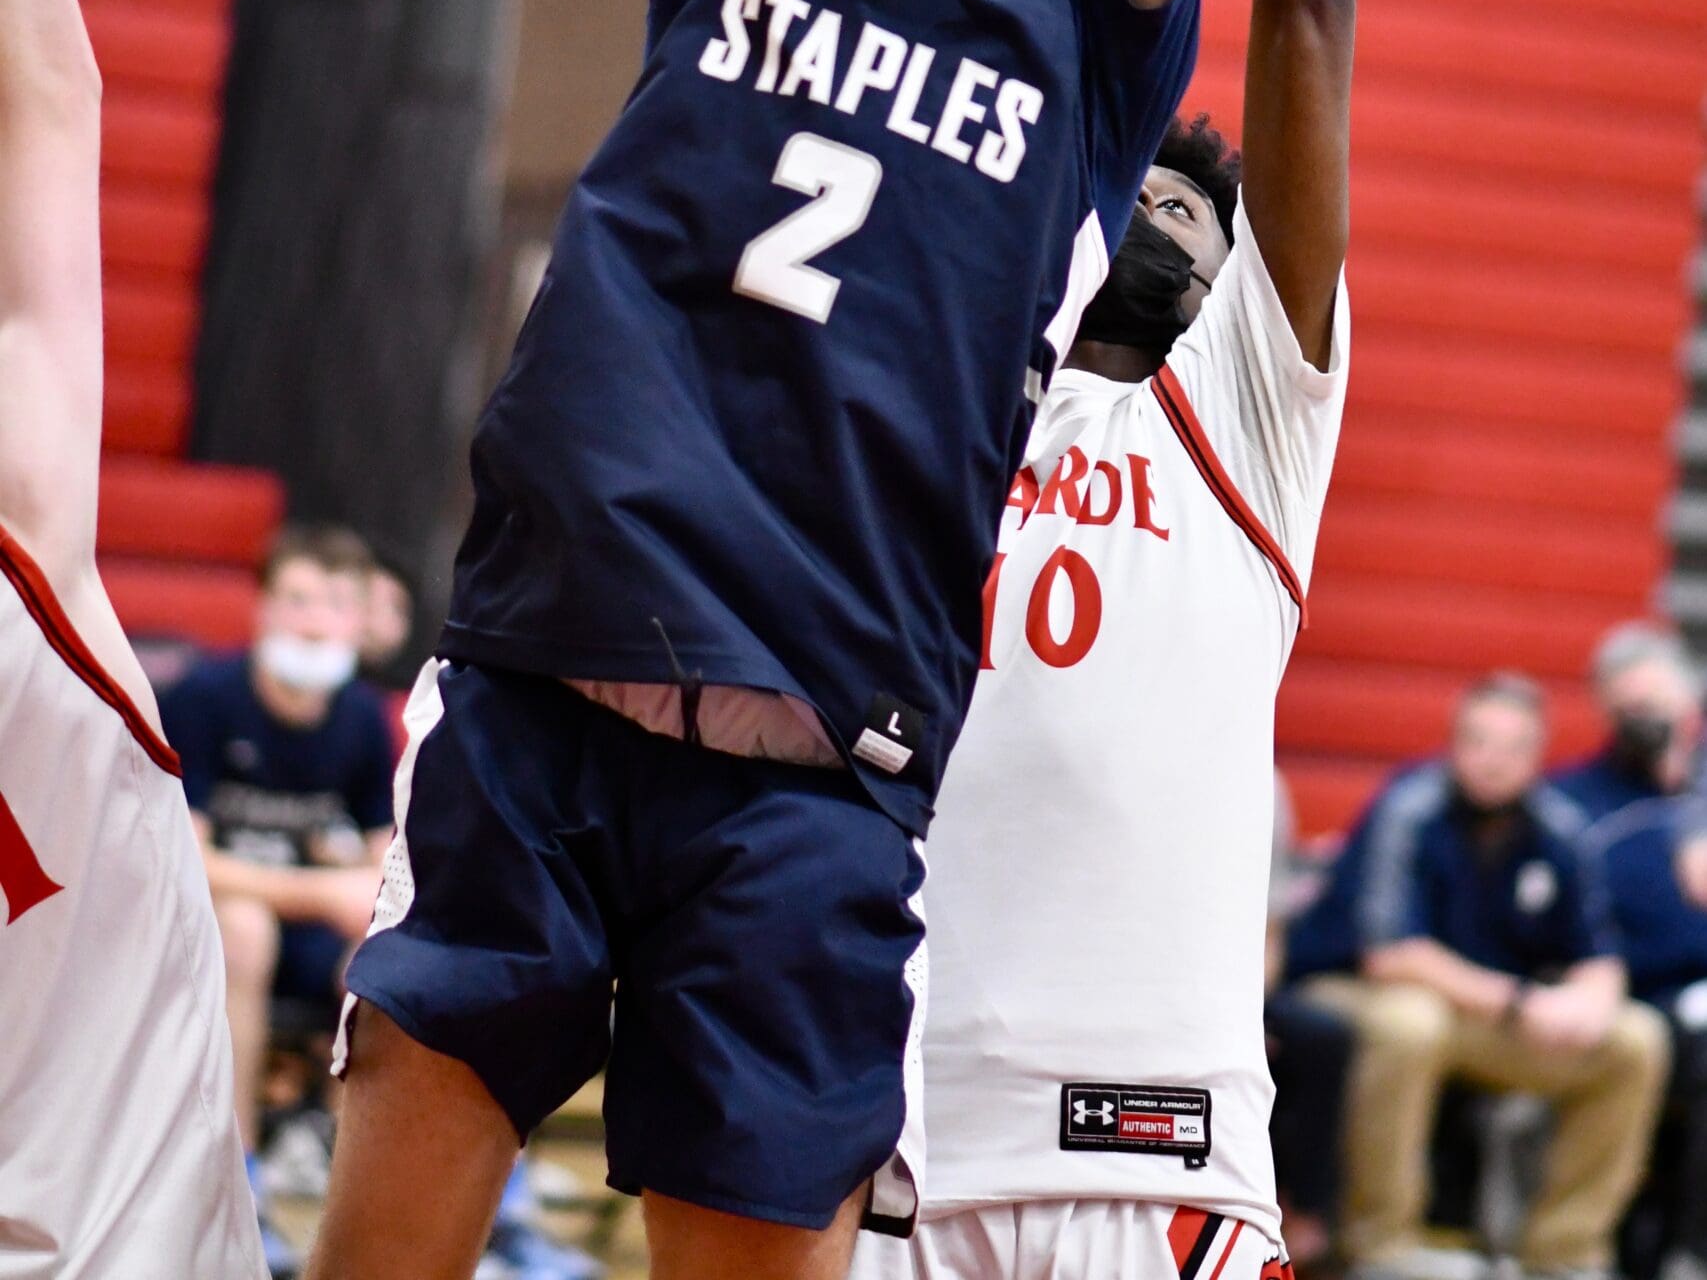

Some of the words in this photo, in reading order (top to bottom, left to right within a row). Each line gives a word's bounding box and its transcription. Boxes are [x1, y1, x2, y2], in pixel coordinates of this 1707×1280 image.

[731, 131, 883, 325] 2
[887, 711, 902, 736] L
[1123, 1099, 1158, 1108] UNDER
[1160, 1101, 1203, 1110] ARMOUR
[1122, 1120, 1171, 1134] AUTHENTIC
[1179, 1125, 1198, 1134] MD
